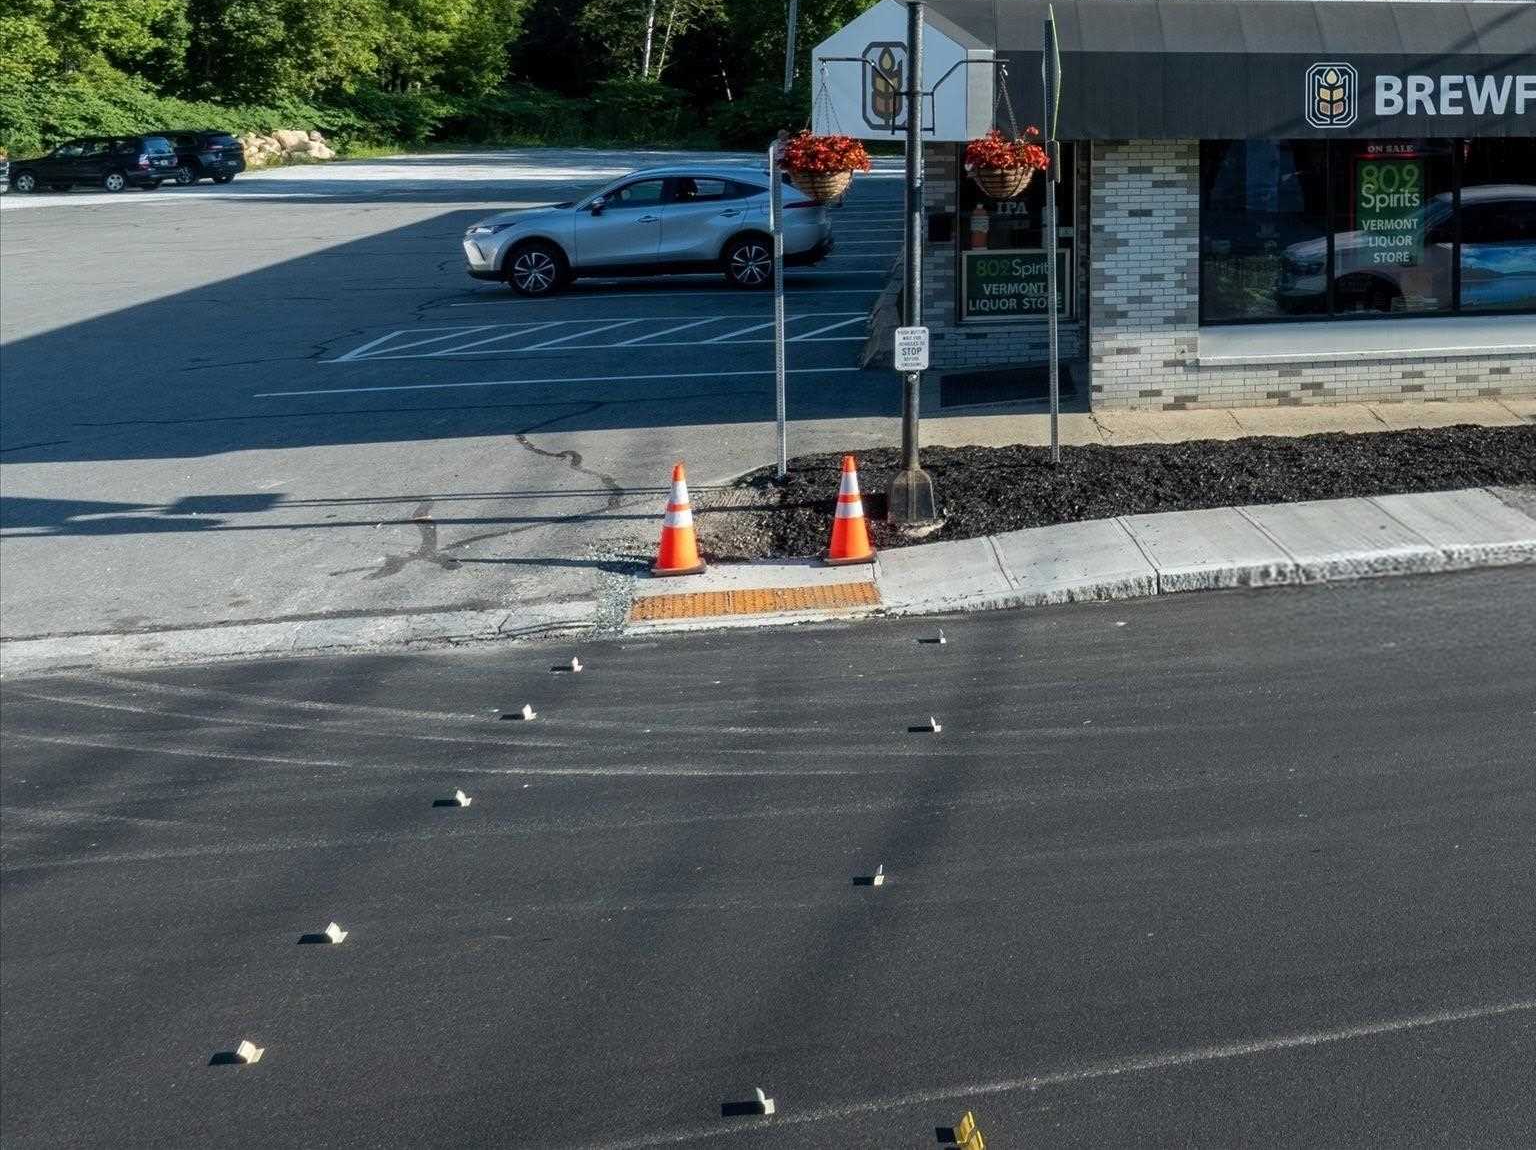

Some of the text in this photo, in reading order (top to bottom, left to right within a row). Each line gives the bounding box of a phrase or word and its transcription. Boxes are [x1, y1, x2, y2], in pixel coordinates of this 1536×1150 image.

[1367, 144, 1415, 153] ON SALE
[1361, 164, 1420, 194] 802
[1361, 184, 1420, 212] Spirits
[996, 201, 1028, 215] IPA
[1362, 218, 1419, 230] VERMONT
[1368, 235, 1413, 248] LIQUOR
[1373, 252, 1410, 263] STORE
[976, 258, 1052, 277] 802 Spirit
[983, 282, 1046, 295] VERMONT
[969, 296, 1062, 311] LIQUOR STOE
[902, 347, 922, 356] STOP
